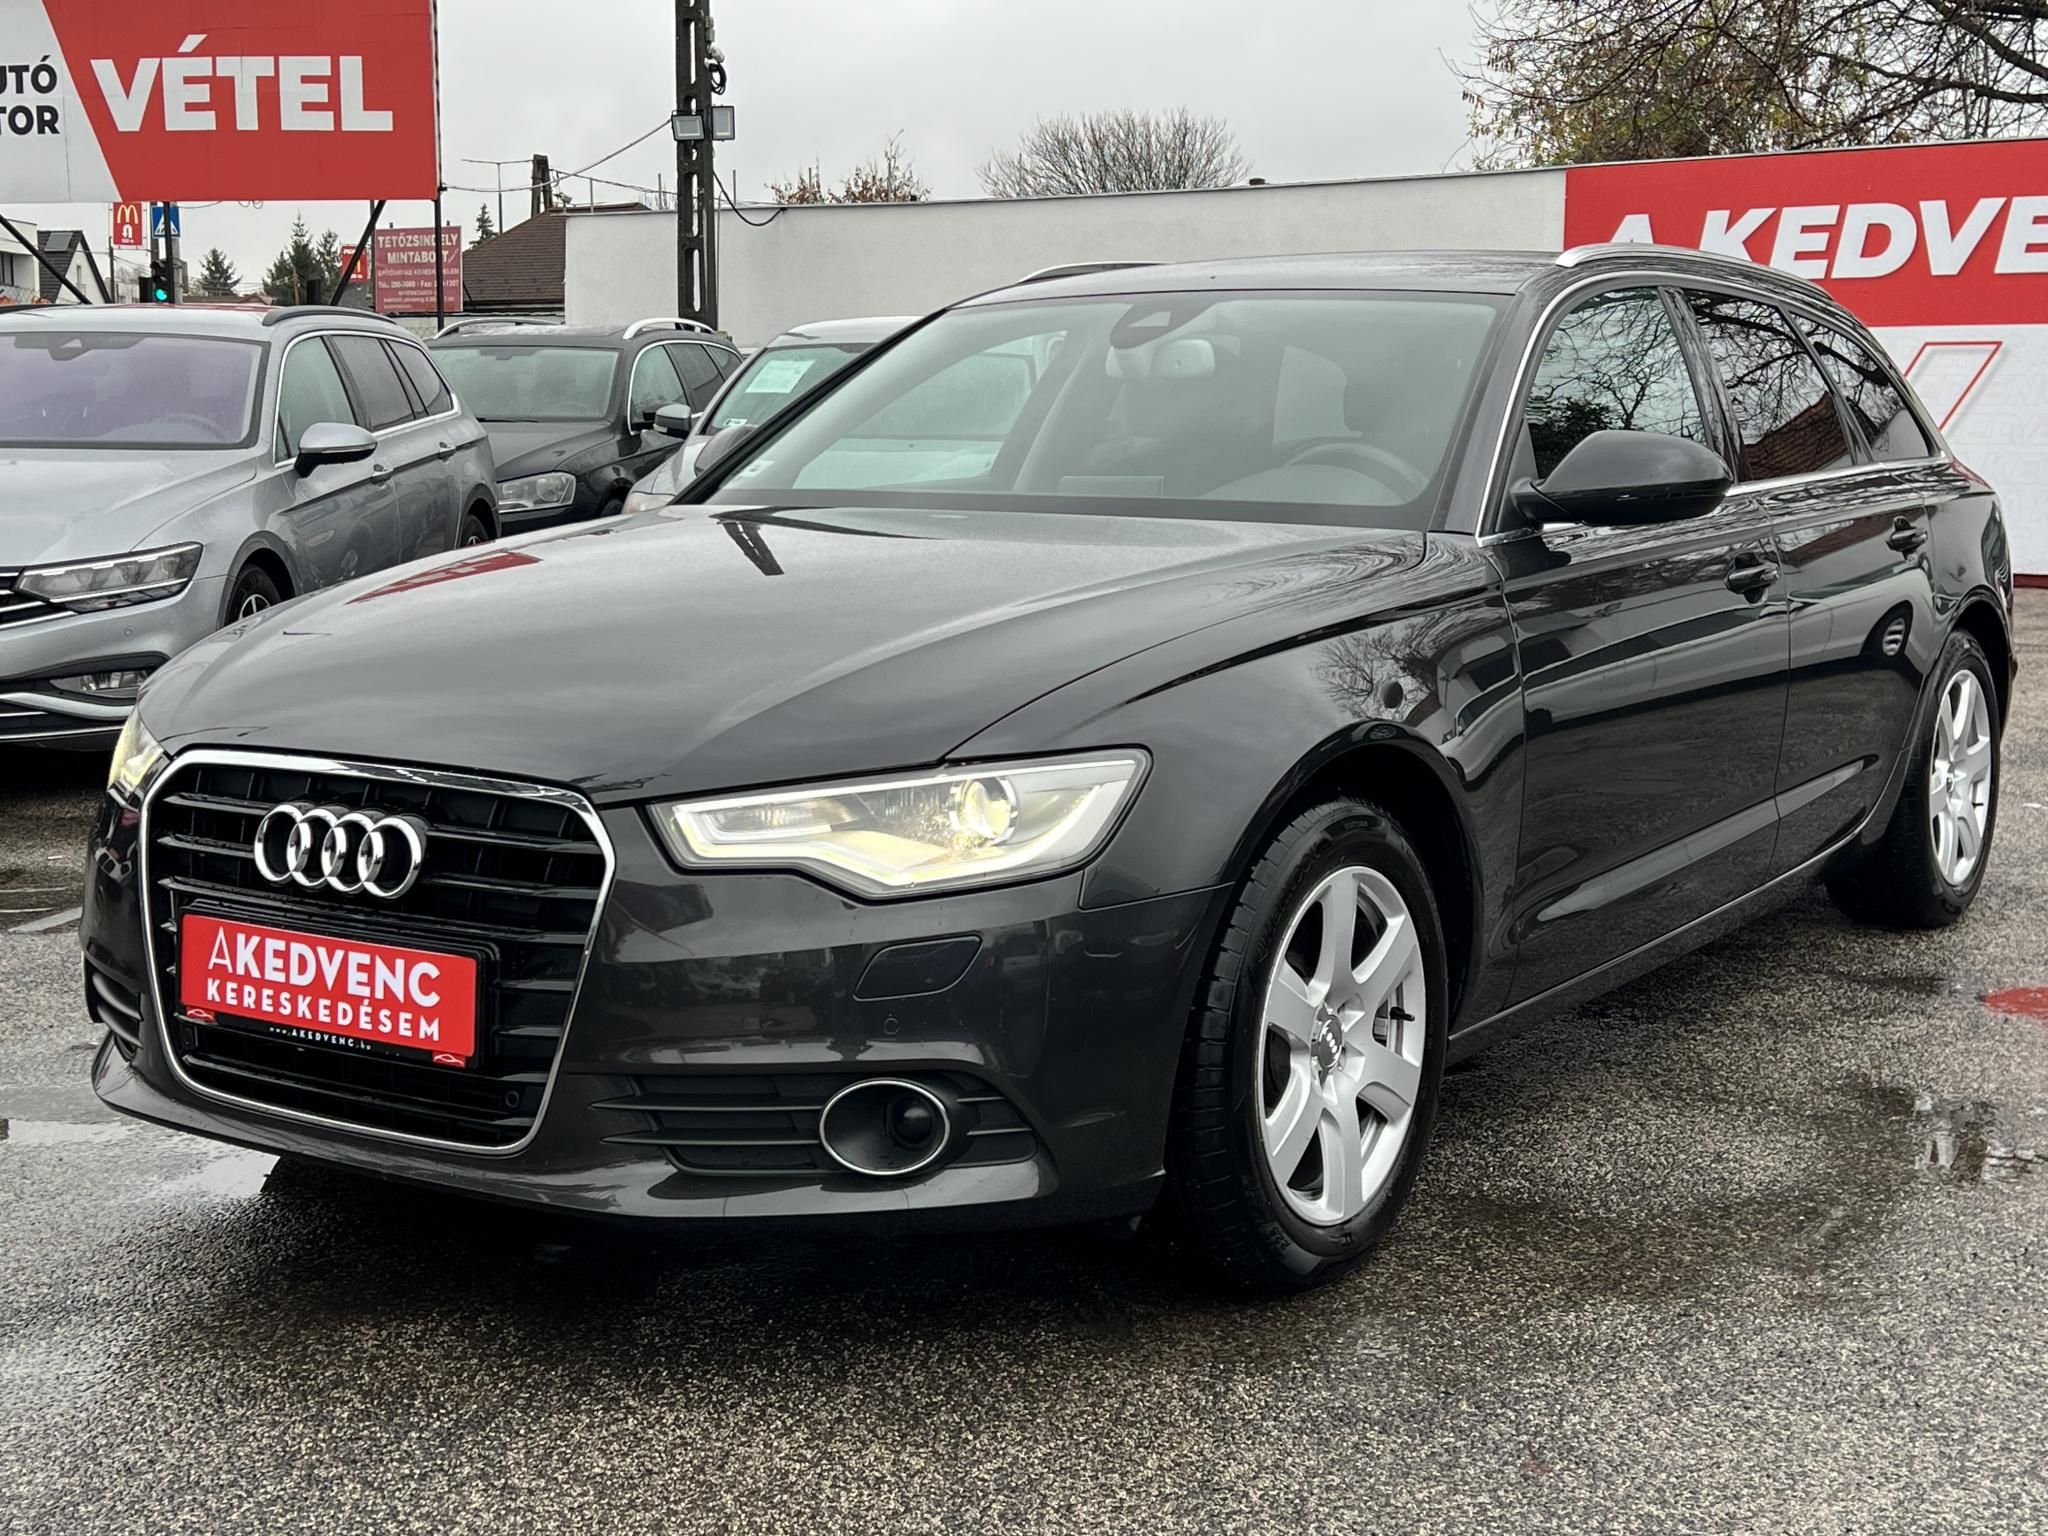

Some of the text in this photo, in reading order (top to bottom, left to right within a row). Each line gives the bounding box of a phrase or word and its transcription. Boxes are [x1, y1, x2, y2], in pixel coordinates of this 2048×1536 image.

[0, 54, 57, 95] TÓ
[90, 34, 394, 132] VÉTEL
[387, 250, 449, 264] MINTABOT
[206, 977, 440, 1042] KERESKEDÉSEM
